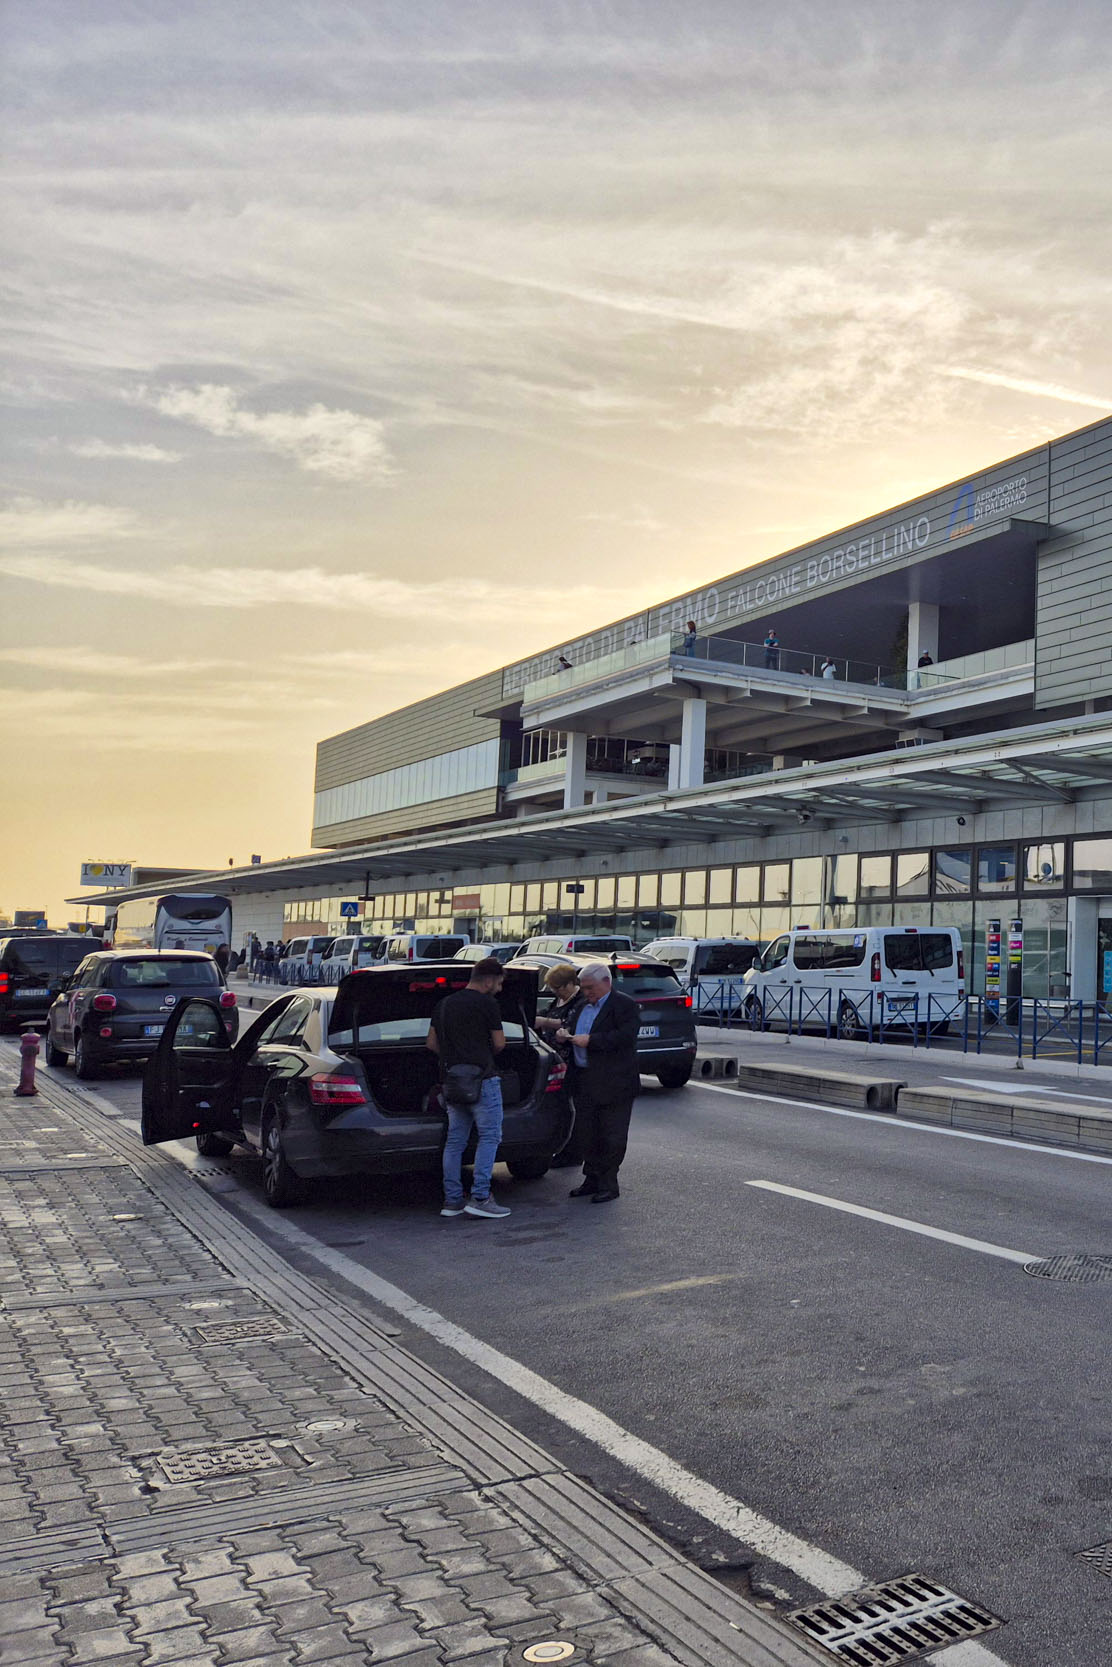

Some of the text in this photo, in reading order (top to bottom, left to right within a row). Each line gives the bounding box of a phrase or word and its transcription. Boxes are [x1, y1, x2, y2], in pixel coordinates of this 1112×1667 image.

[974, 491, 1027, 521] DI PALERMO
[975, 477, 1027, 508] AEROPORTO
[727, 565, 801, 617] FALCONE
[806, 516, 930, 588] BORSELLINO
[83, 863, 129, 876] I NY
